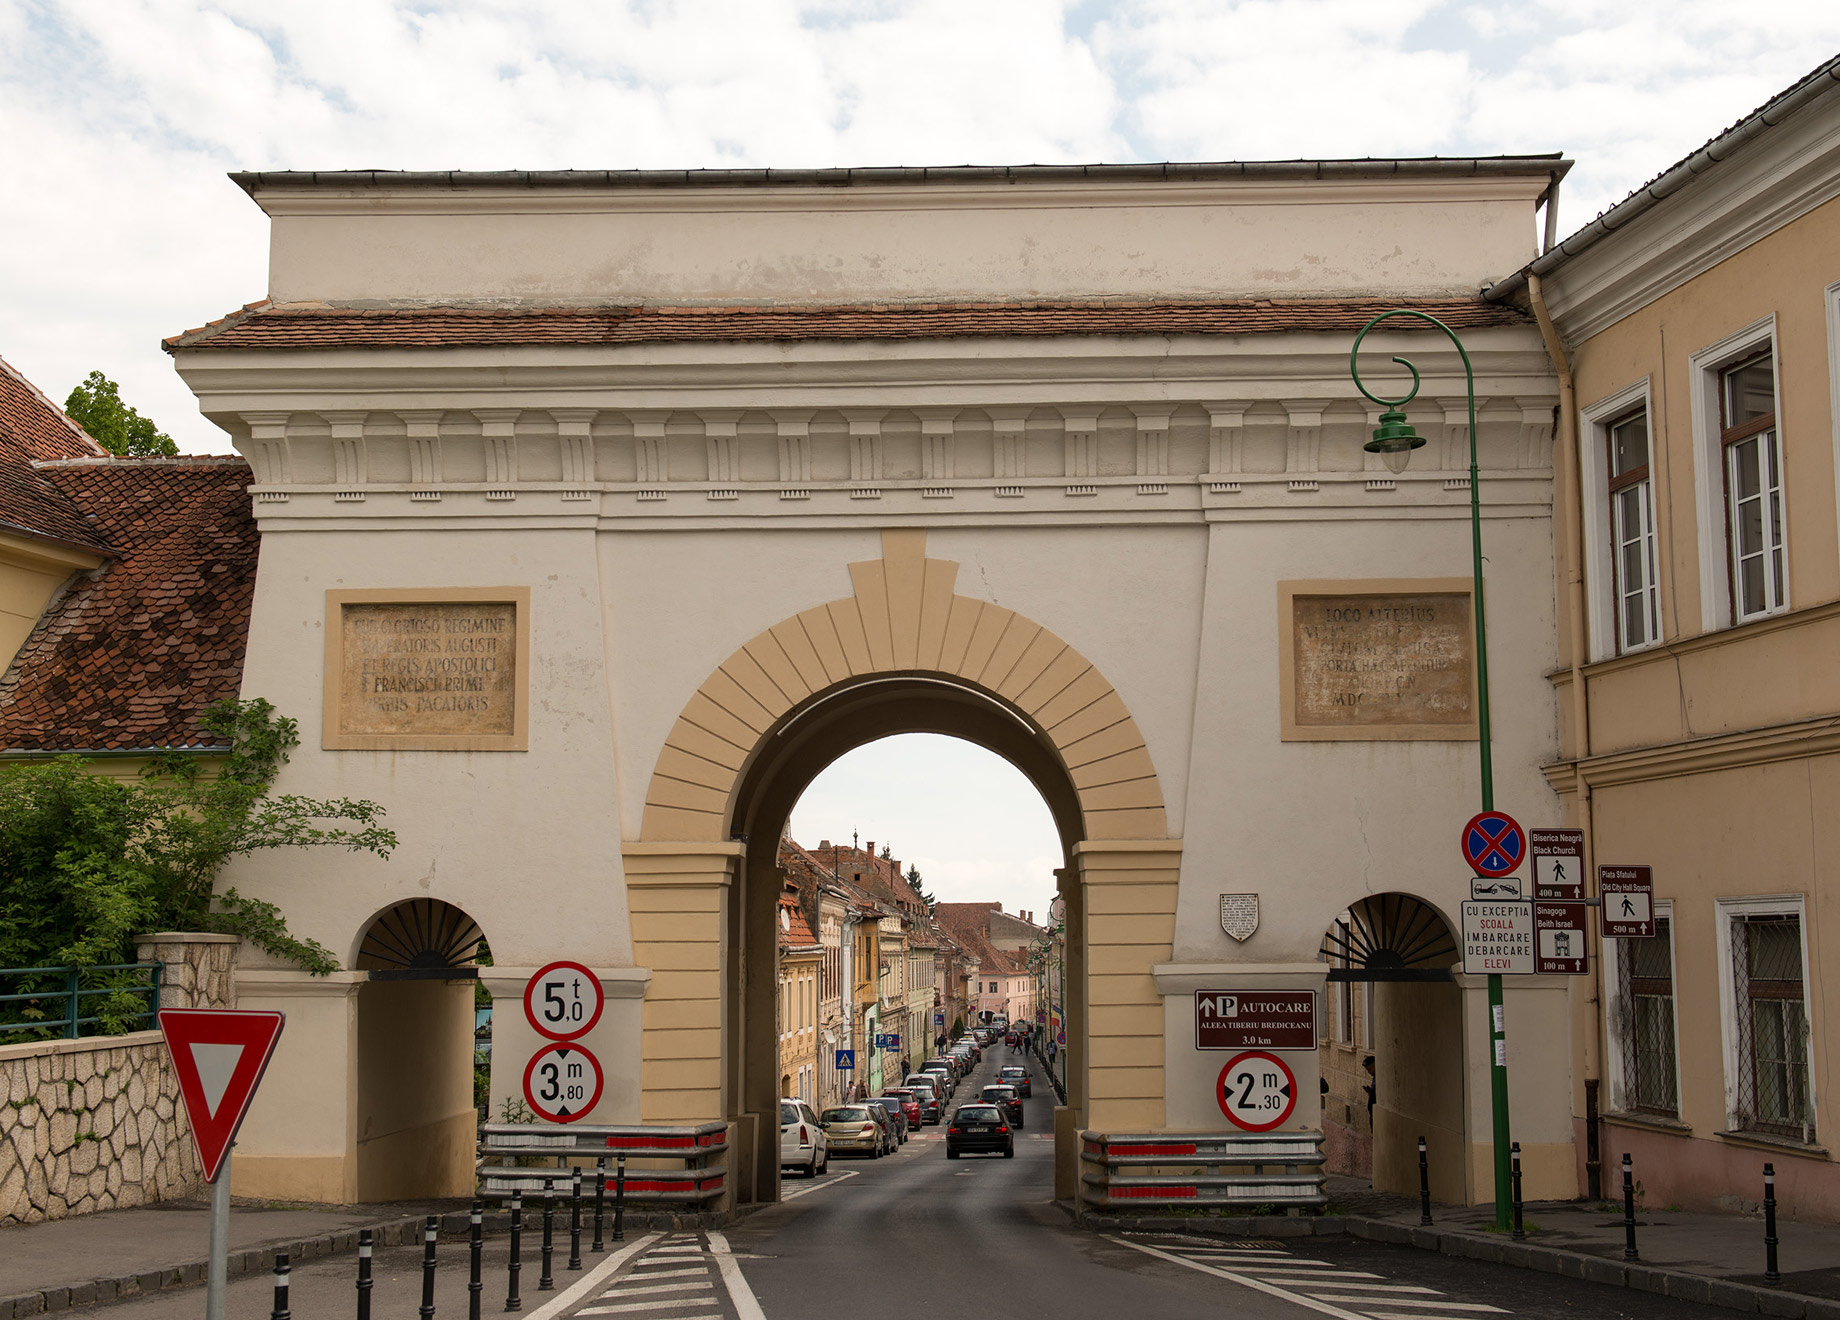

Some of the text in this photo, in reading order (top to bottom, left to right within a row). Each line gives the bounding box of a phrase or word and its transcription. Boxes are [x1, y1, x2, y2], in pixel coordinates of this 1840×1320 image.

[1326, 608, 1362, 623] LOCO
[445, 618, 506, 634] REGIMINE
[445, 637, 497, 653] AUGUSTI
[382, 657, 420, 673] REGIS
[425, 657, 497, 674] APOSTOLICI
[445, 677, 484, 692] PRIMI
[1533, 833, 1559, 842] Biserica
[1533, 846, 1576, 855] Black Church
[1539, 889, 1553, 897] 400
[1602, 883, 1651, 893] Old City Hall Square
[1466, 906, 1478, 916] CU
[1537, 907, 1567, 917] Sinagoga
[1537, 920, 1573, 928] Beith Israel
[1612, 925, 1627, 934] 500
[1468, 945, 1530, 956] DEBARCARE
[1484, 959, 1511, 969] ELEVI
[1543, 962, 1556, 970] 100
[1240, 1002, 1311, 1013] AUTOCARE
[1242, 1035, 1272, 1045] 3.0 km
